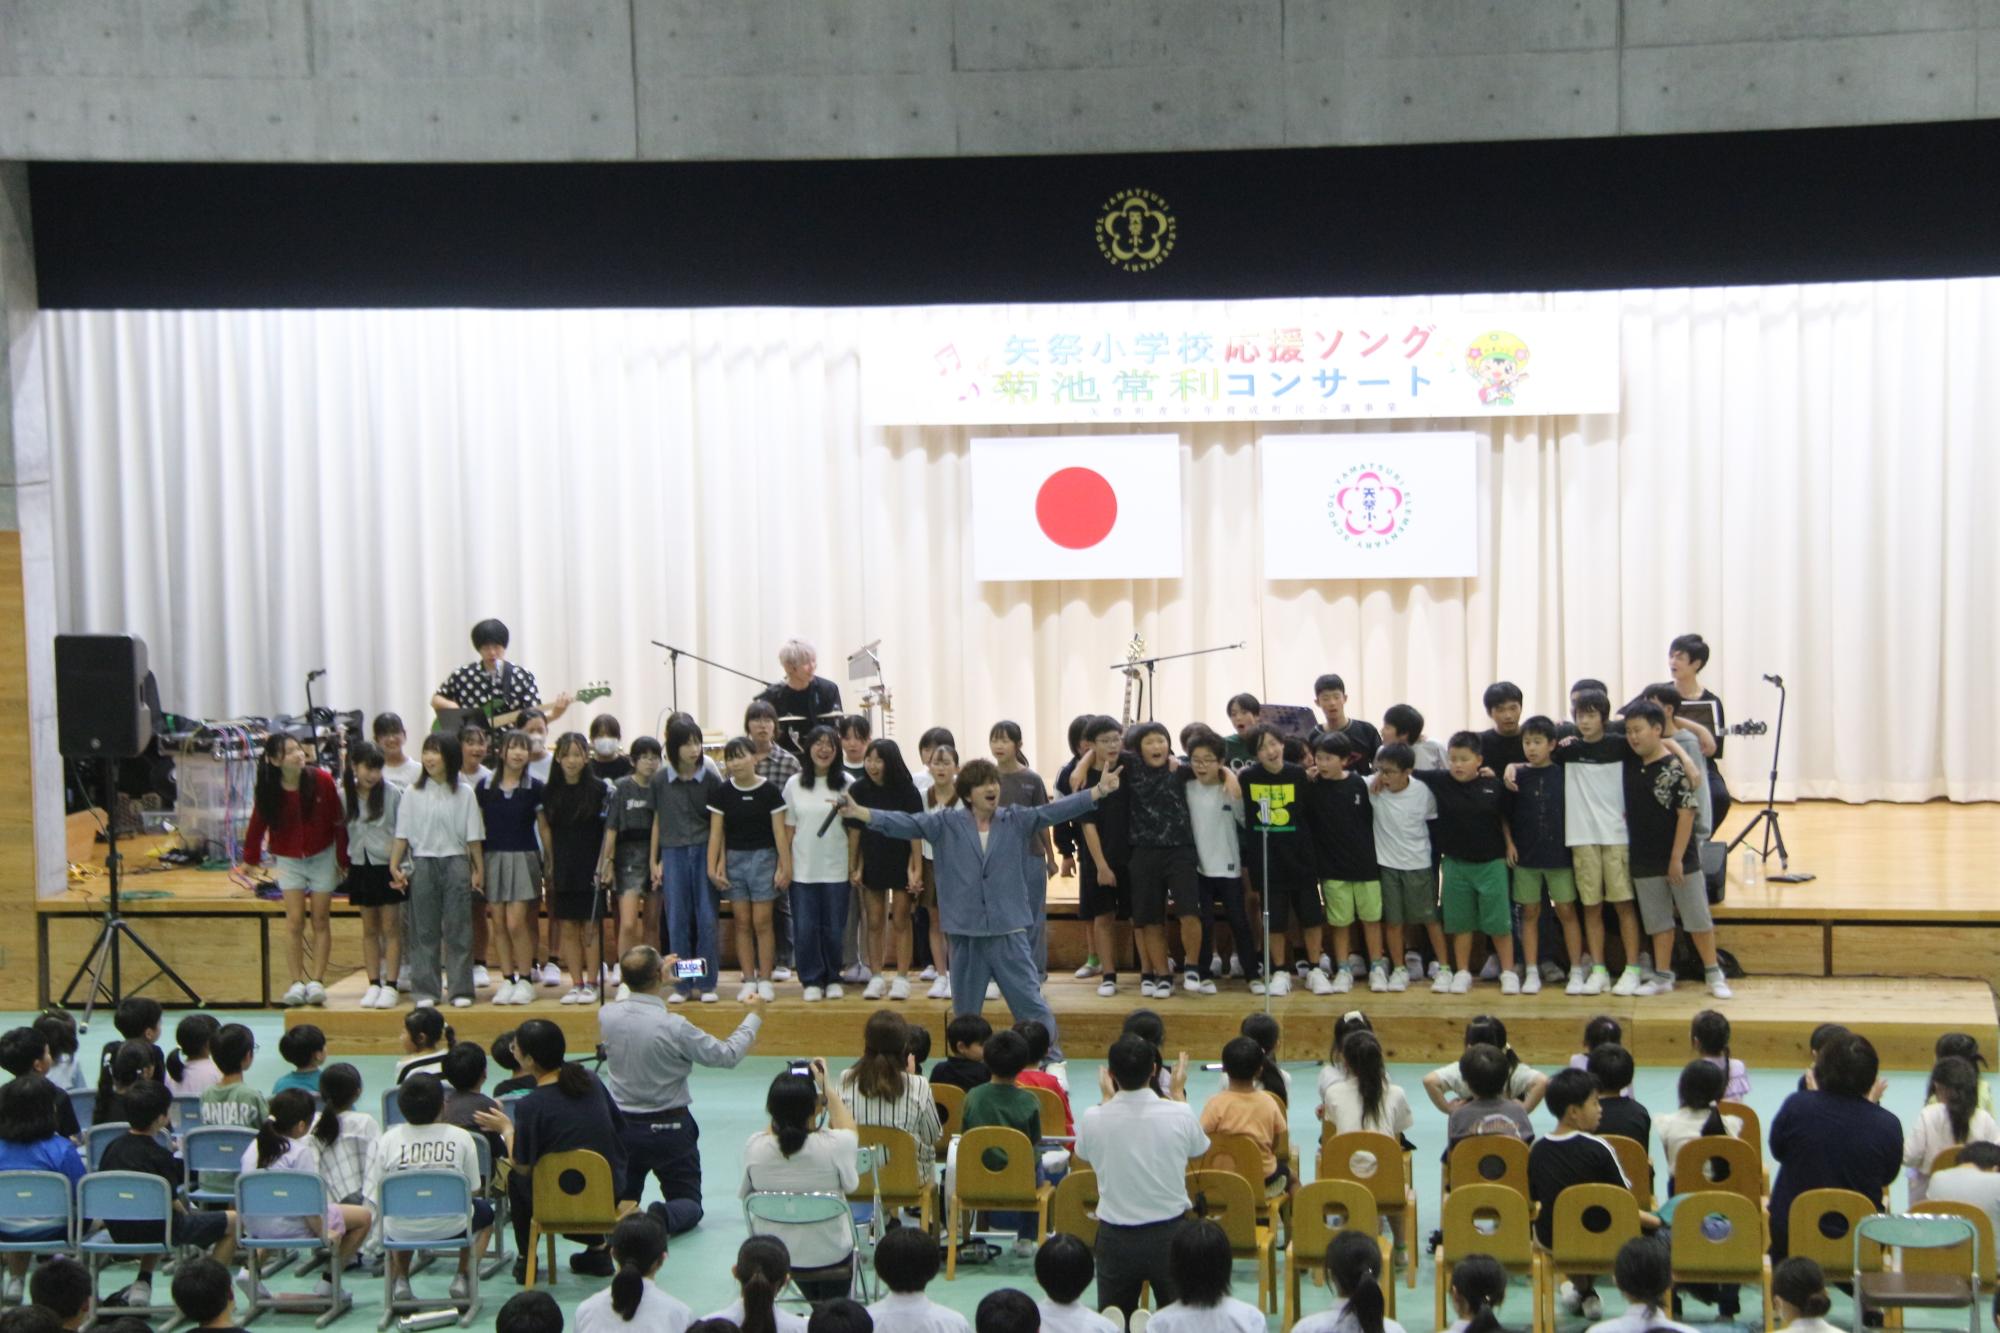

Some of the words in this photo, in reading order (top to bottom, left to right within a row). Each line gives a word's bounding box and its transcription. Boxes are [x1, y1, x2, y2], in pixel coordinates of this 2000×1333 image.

[1102, 187, 1170, 212] YAMATSURI
[1094, 216, 1118, 266] SCHOOL
[1122, 215, 1177, 273] ELEMENTARY
[1003, 324, 1438, 366] 矢祭小学校応援ソング
[991, 365, 1432, 404] 菊池常利コンサート
[1335, 463, 1405, 486] YAMATSURI
[1327, 493, 1351, 542] SCHOOL
[399, 1141, 457, 1164] LOGOS
